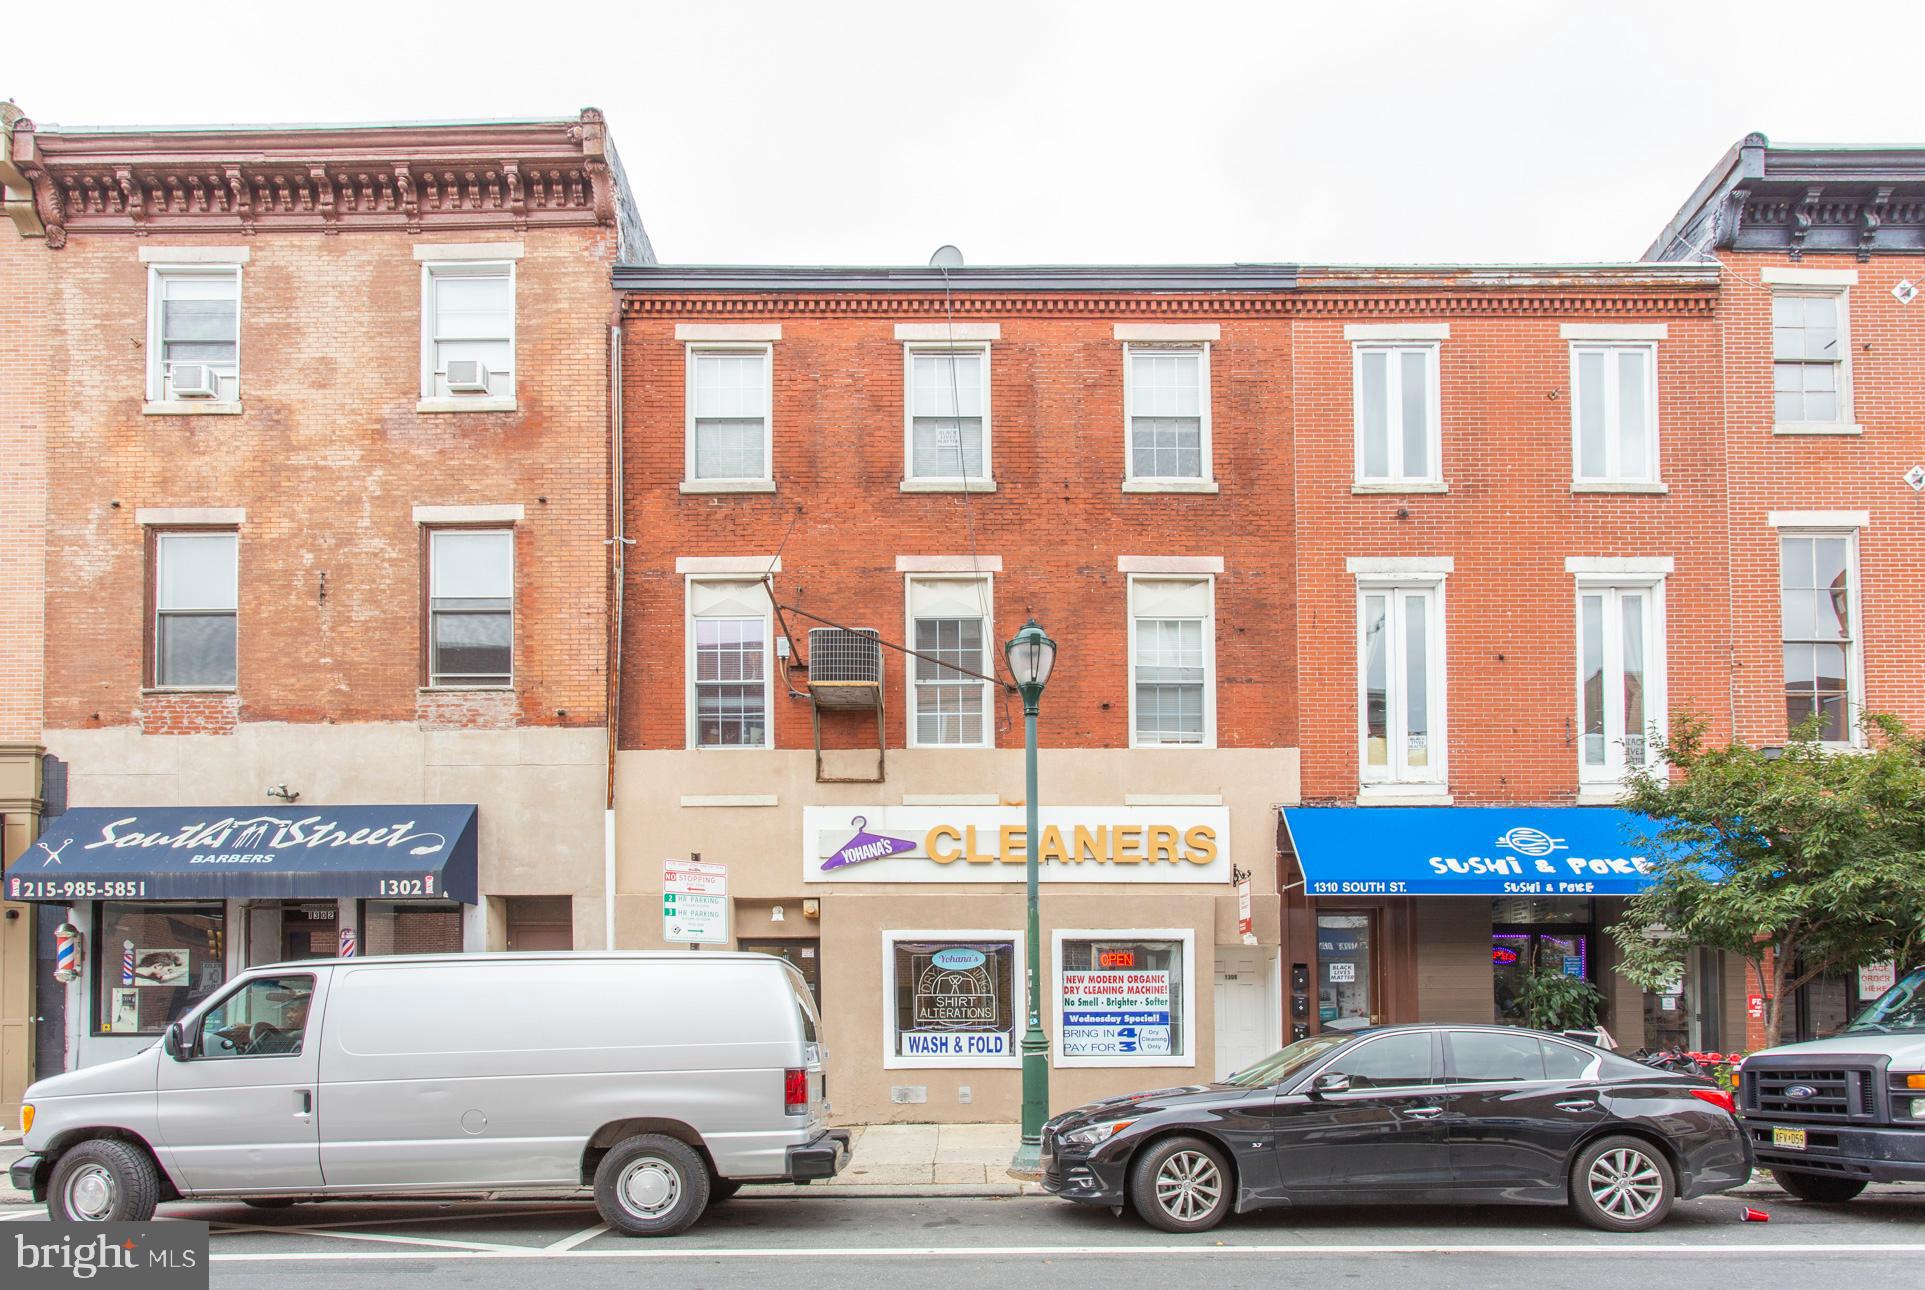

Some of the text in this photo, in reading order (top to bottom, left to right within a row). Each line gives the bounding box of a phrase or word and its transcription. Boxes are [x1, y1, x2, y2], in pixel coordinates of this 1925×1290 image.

[84, 816, 416, 849] South Street
[925, 824, 1218, 865] CLEANERS
[841, 838, 893, 863] YOHANA'S
[190, 854, 275, 864] BARBERS
[1535, 859, 1556, 874] &
[665, 872, 716, 884] NO STOPPING
[24, 880, 421, 897] 215-985-5851 1302
[1314, 882, 1407, 893] 1310 SOUTH ST.
[1545, 884, 1554, 892] &
[690, 896, 720, 905] PARKING
[678, 909, 687, 917] HR
[690, 910, 720, 918] PARKING
[938, 954, 980, 964] Yohana's
[1101, 953, 1133, 966] OPEN
[921, 970, 939, 993] DRY
[1066, 975, 1165, 984] NEW MODERN ORGANIC
[1064, 986, 1168, 995] DRY CLEANING MACHINE!
[936, 996, 976, 1007] SHIRT
[1065, 997, 1168, 1008] No Smell Brighter Softer
[920, 1007, 992, 1018] ALTERATIONS
[1069, 1014, 1160, 1024] Wednesday Special!
[1064, 1028, 1137, 1038] BRING IN 4
[908, 1036, 1003, 1053] WASH & FOLD
[1064, 1042, 1137, 1052] PAY FOR 3
